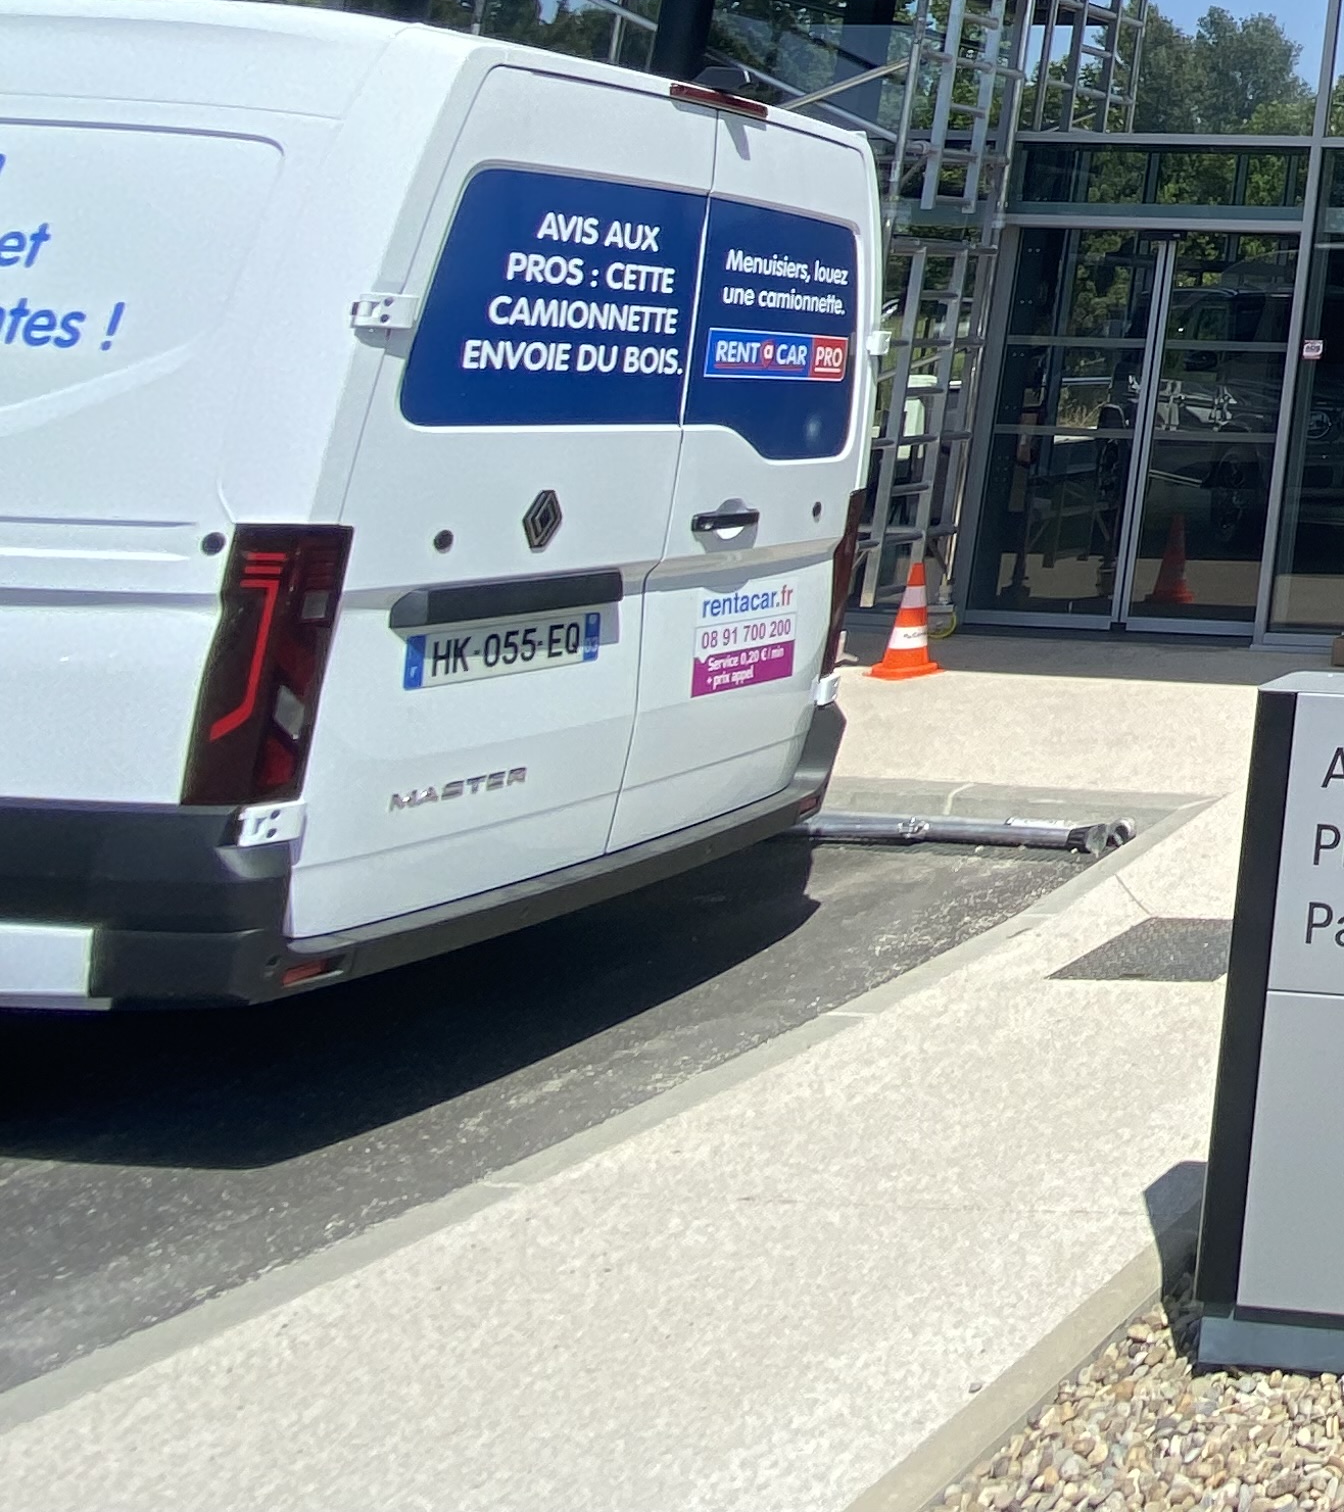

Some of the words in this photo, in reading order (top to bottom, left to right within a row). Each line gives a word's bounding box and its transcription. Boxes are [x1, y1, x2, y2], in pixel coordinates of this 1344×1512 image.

[537, 212, 599, 245] AVIS
[604, 221, 660, 252] AUX
[507, 252, 584, 286] PROS
[606, 262, 676, 294] CETTE
[726, 249, 811, 284] Menuisiers,
[814, 260, 849, 286] louez
[488, 295, 679, 335] CAMIONNETTE
[723, 286, 756, 306] une
[758, 288, 846, 315] camionnette.
[462, 340, 572, 371] ENVOIE
[576, 344, 618, 373] DU
[623, 346, 683, 375] BOIS.
[715, 339, 761, 363] RENT
[763, 344, 774, 360] a
[776, 343, 808, 366] CAR
[815, 346, 843, 368] PRO
[702, 584, 793, 618] rentacar.fr
[701, 630, 718, 649] 08
[722, 627, 738, 646] 91
[743, 622, 766, 642] 700
[769, 618, 791, 639] 200
[708, 655, 739, 672] Service
[712, 671, 731, 690] prix
[731, 665, 754, 686] appel
[389, 766, 528, 813] MASTER
